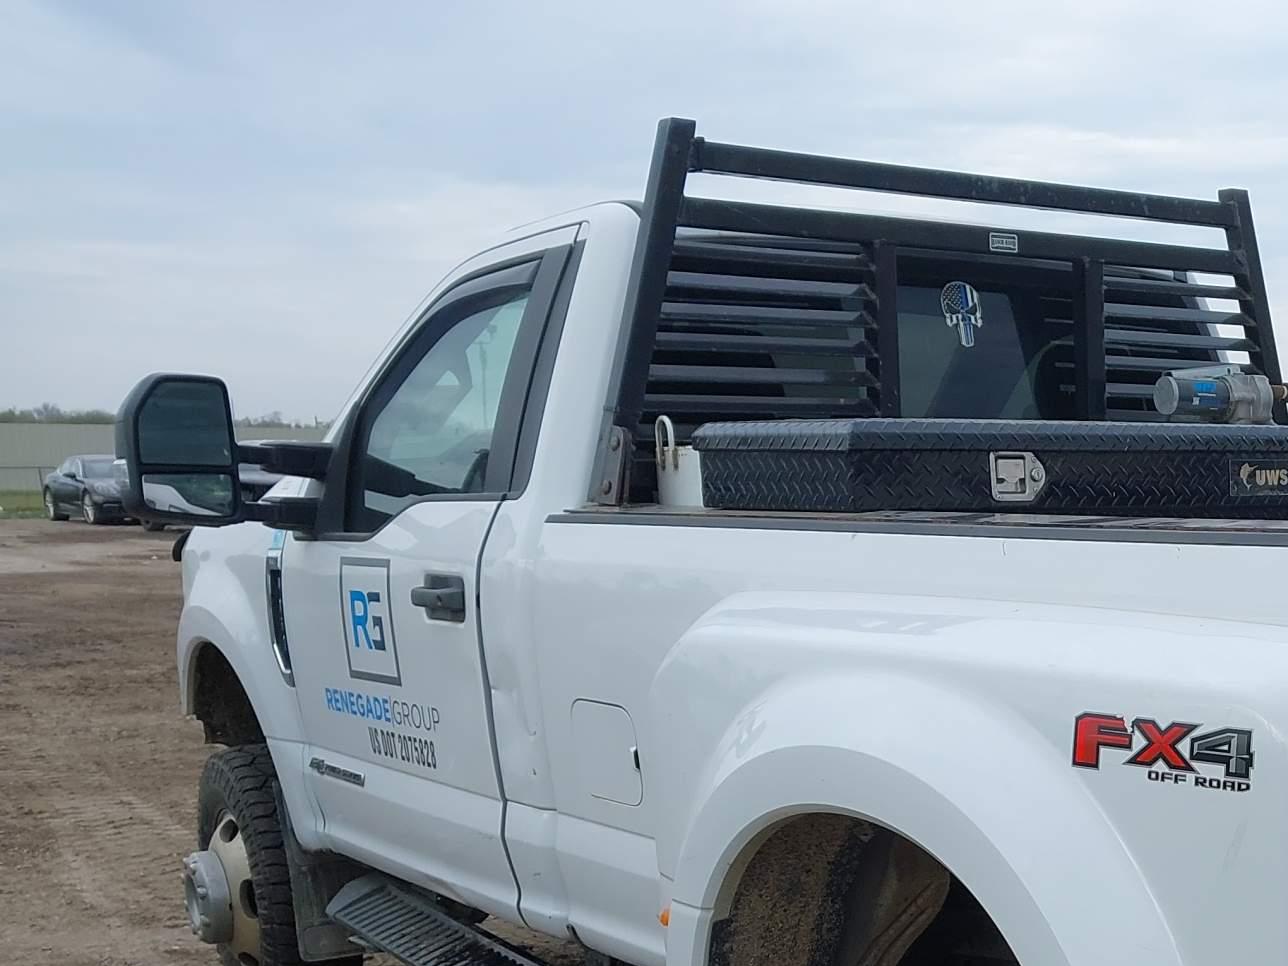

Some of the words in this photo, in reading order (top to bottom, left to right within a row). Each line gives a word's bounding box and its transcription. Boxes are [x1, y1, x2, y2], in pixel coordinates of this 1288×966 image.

[1255, 468, 1288, 486] UWS
[349, 589, 387, 652] RG
[325, 687, 391, 723] RENEGADE
[392, 699, 440, 732] GROUP
[368, 726, 382, 755] US
[380, 728, 399, 759] DOT
[398, 733, 438, 769] 2075828
[1072, 710, 1256, 781] FX4
[1147, 770, 1187, 785] OFF
[1194, 776, 1250, 793] ROAD
